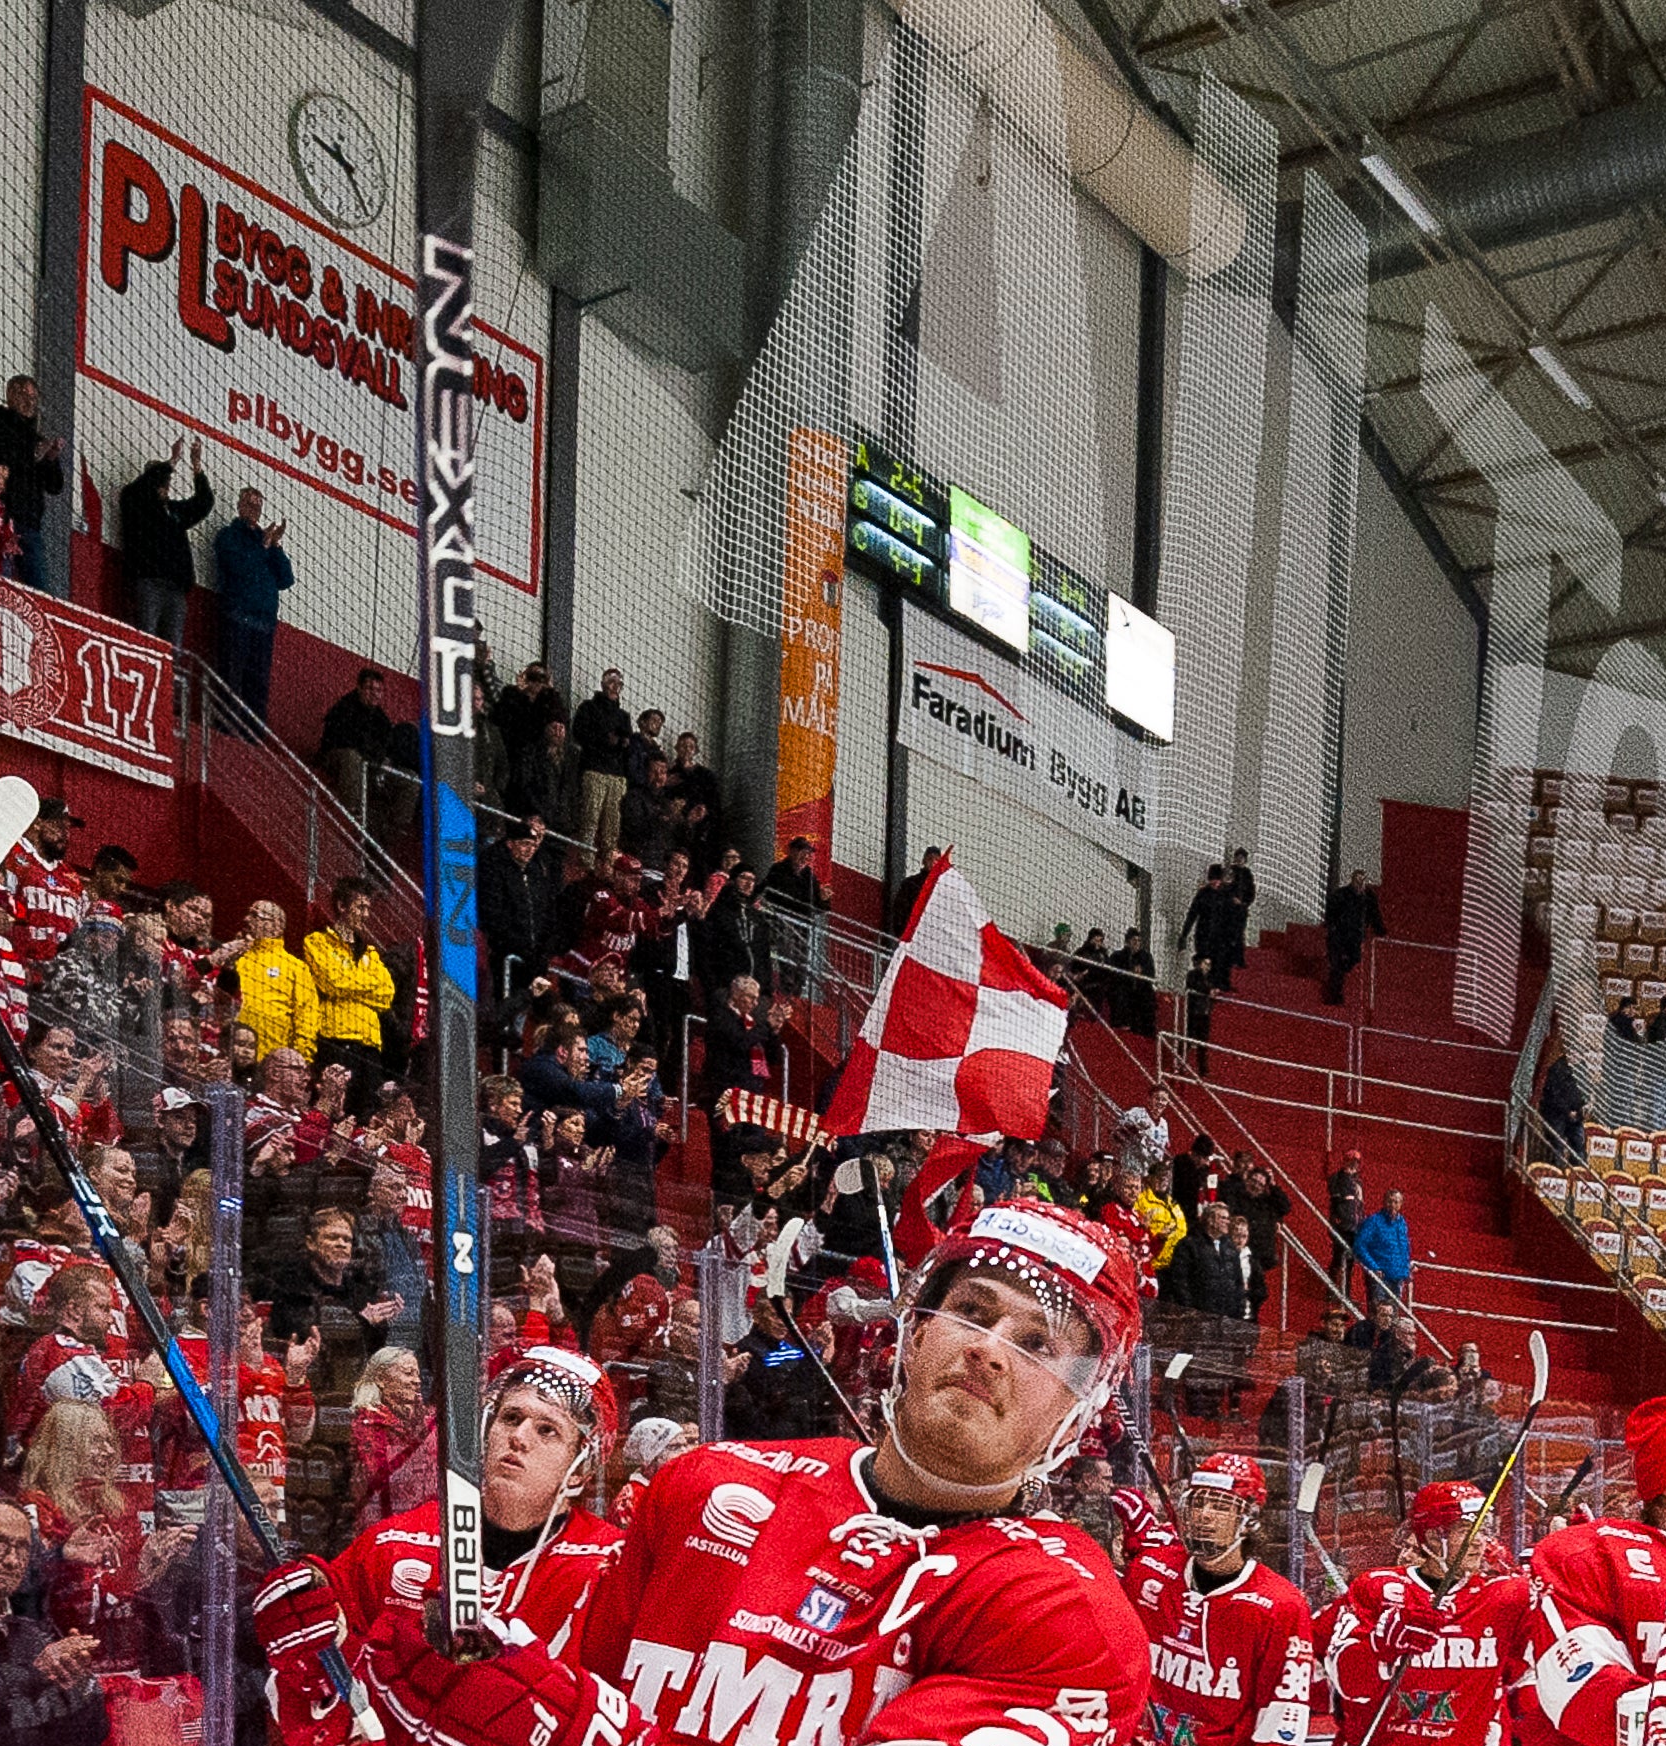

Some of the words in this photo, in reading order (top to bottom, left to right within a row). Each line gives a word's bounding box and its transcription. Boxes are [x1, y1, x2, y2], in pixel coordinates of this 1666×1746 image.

[100, 140, 234, 352] PL
[215, 202, 313, 301] BYGG
[320, 265, 348, 324] &
[355, 283, 528, 423] INRING
[212, 259, 408, 411] SUNDSVALL
[228, 387, 419, 507] plbygg.se
[78, 639, 162, 750] 17
[911, 671, 1035, 771] Faradium
[1050, 748, 1110, 818] Bygg
[1115, 788, 1146, 831] AB
[709, 1440, 830, 1478] stadium
[453, 1503, 478, 1627] BAUE
